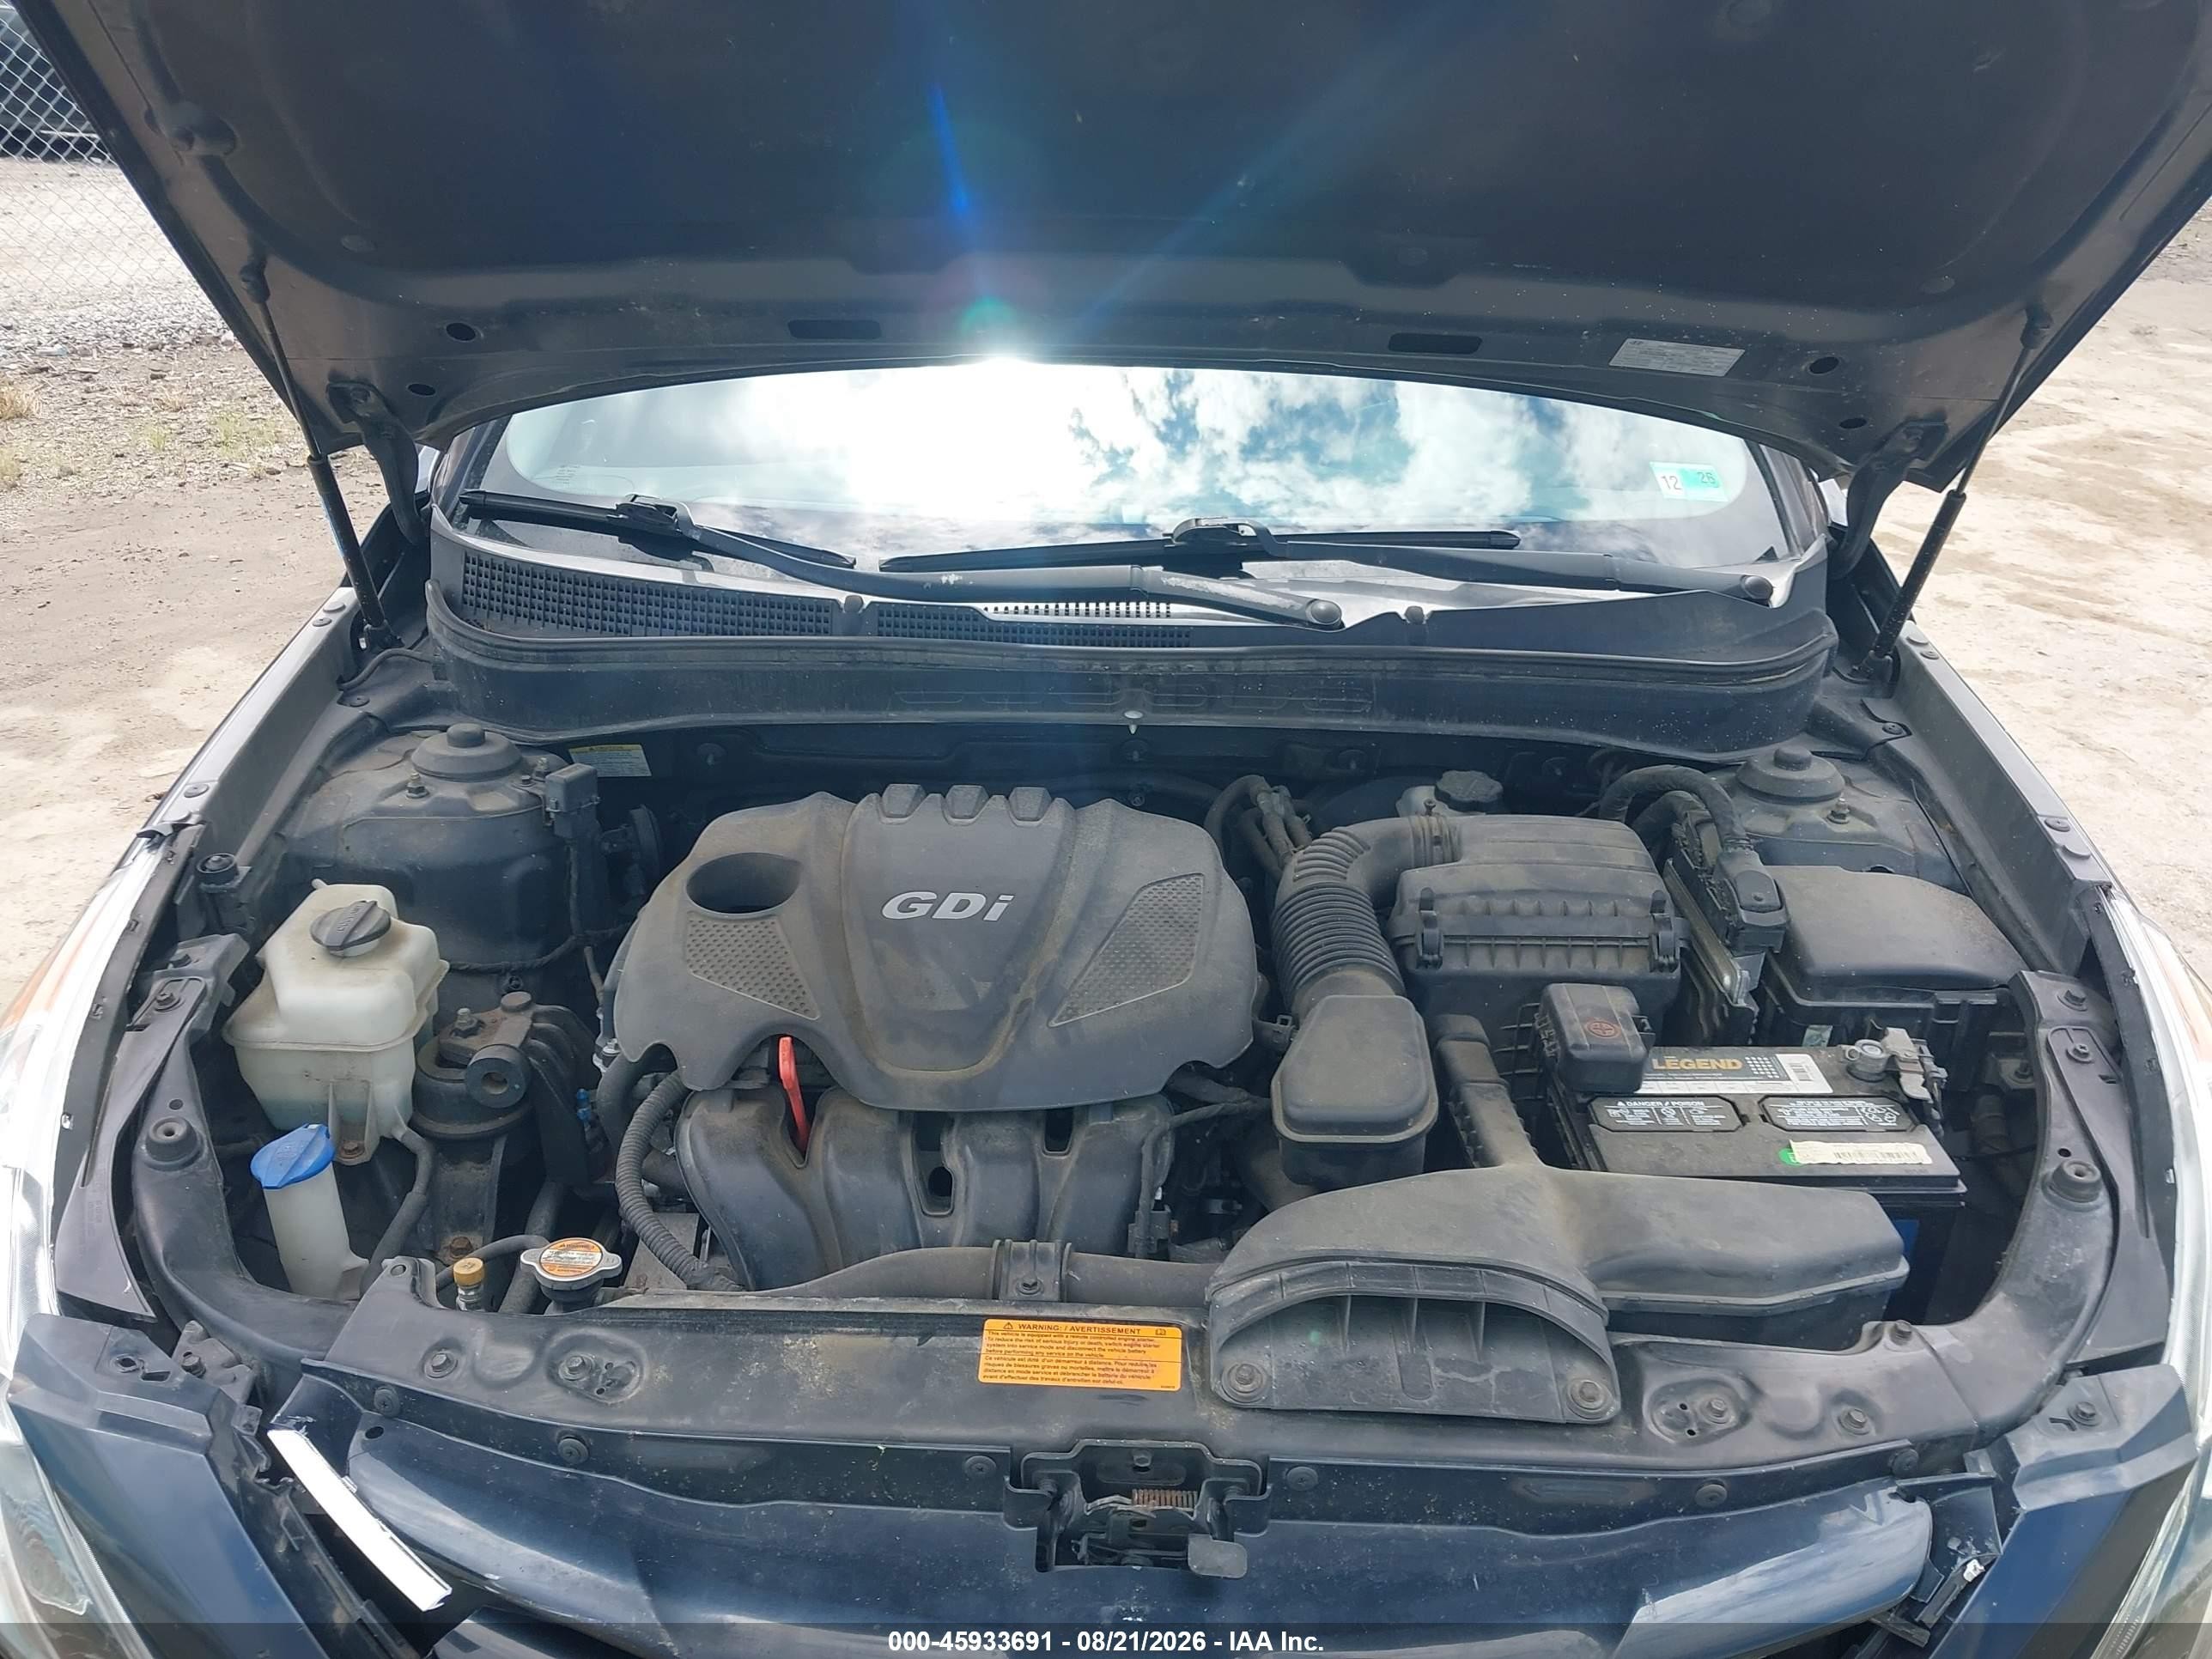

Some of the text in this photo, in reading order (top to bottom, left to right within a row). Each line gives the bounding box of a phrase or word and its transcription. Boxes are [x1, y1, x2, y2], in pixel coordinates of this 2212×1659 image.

[1661, 475, 1684, 490] 12
[881, 890, 1015, 921] GDi
[1651, 1058, 1743, 1071] LEGEND
[1069, 1325, 1140, 1334] AVERTISSEMENT
